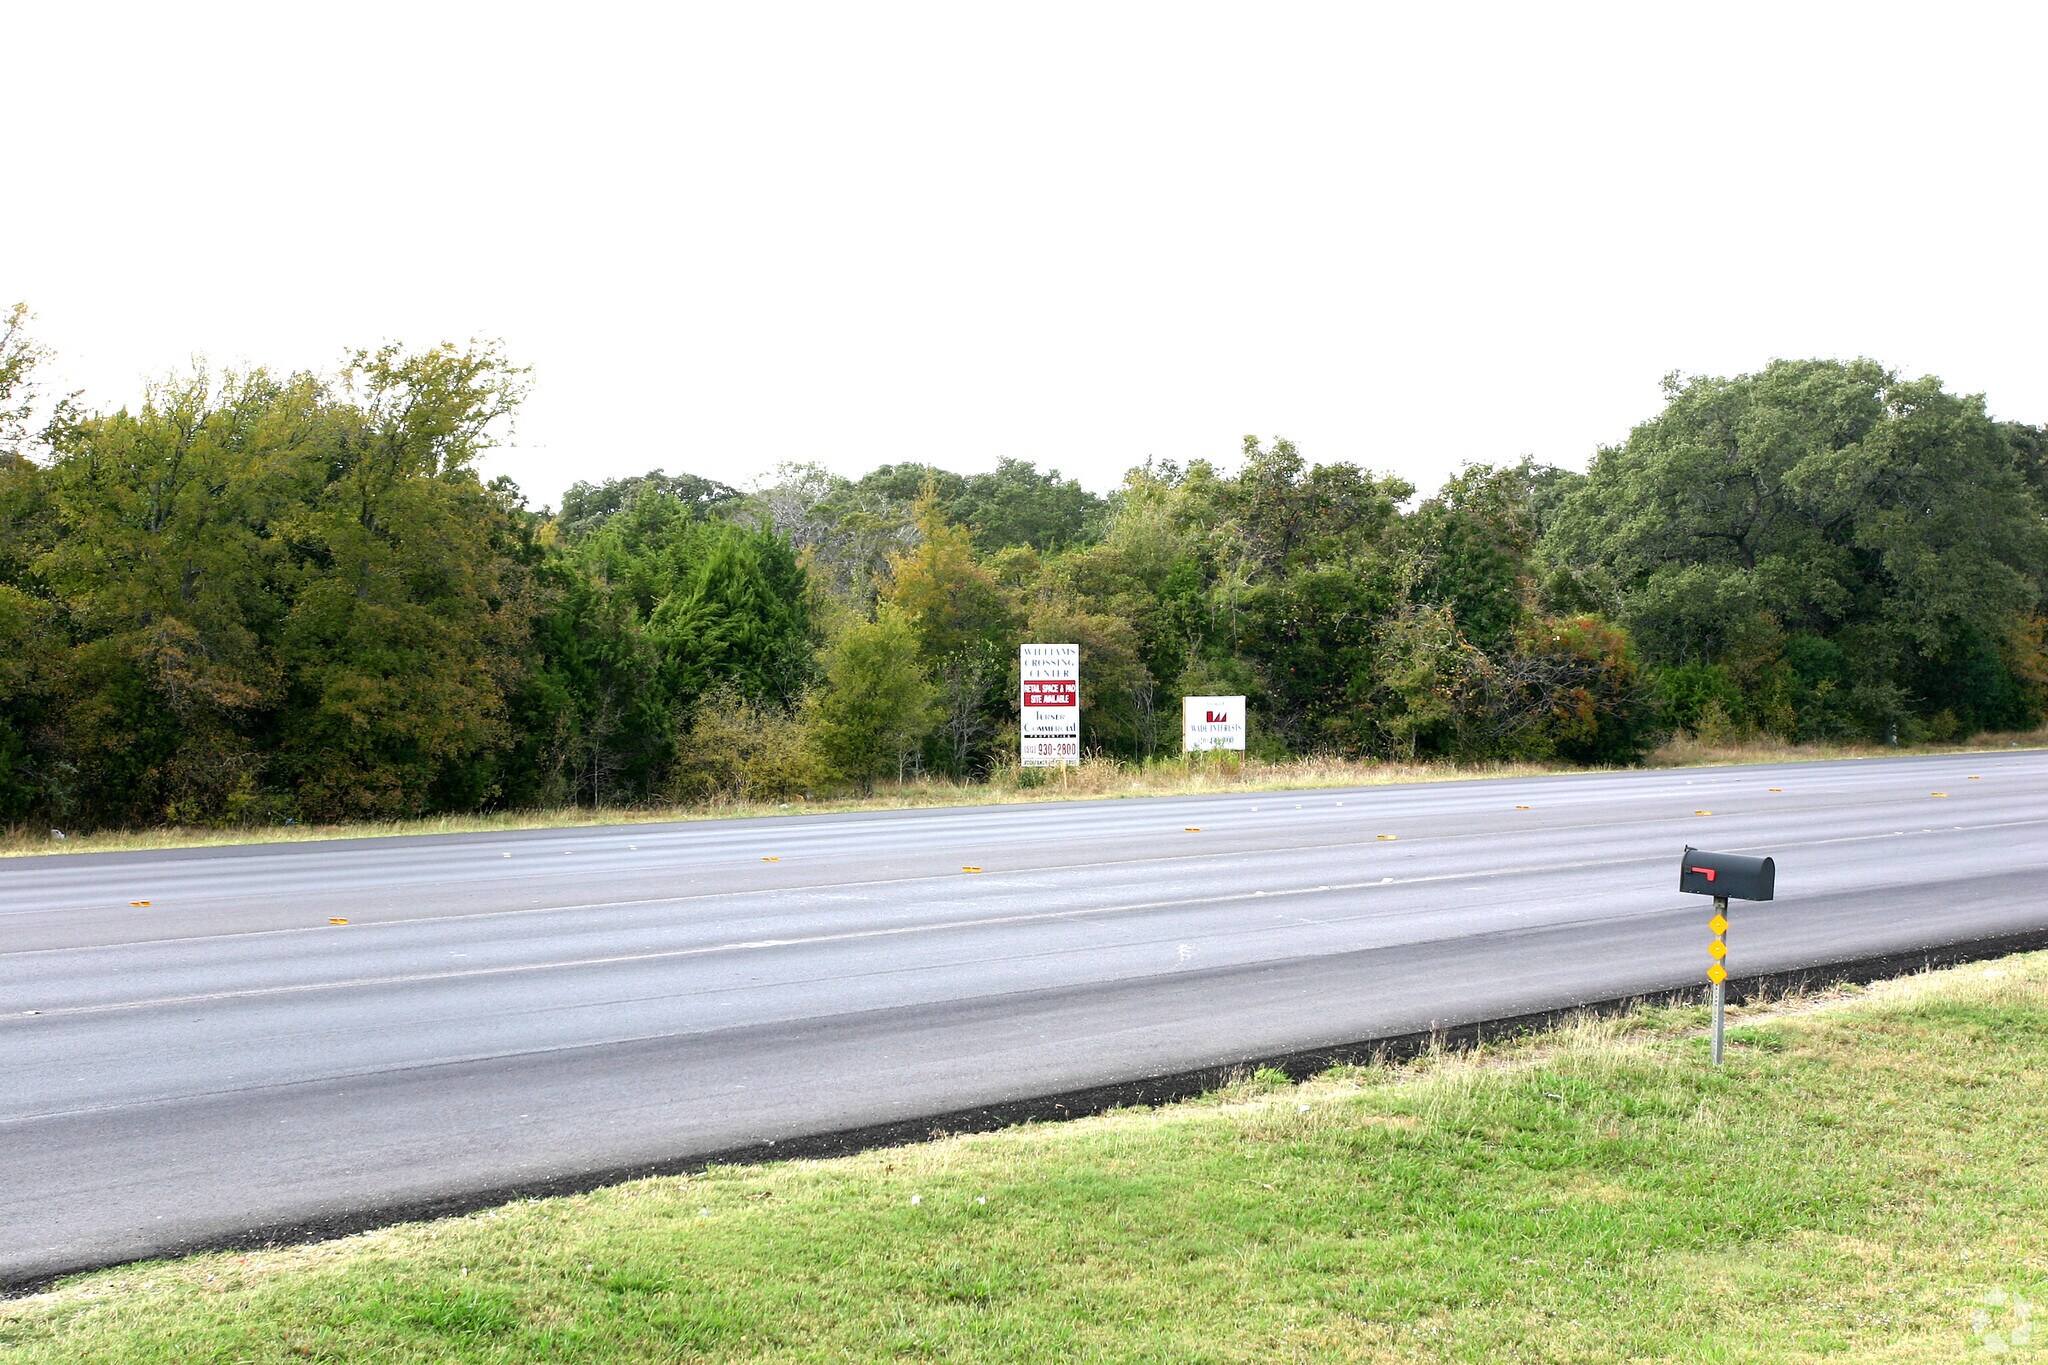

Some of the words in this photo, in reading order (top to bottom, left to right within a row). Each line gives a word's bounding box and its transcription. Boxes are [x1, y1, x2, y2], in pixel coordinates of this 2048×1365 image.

[1024, 648, 1076, 656] WILLIAMS
[1024, 659, 1075, 667] CROSSING
[1029, 670, 1069, 678] CENTER
[1024, 684, 1041, 693] RETAIL
[1042, 684, 1059, 693] SPACE
[1065, 684, 1076, 693] PAD
[1030, 694, 1042, 704] SITE
[1043, 694, 1070, 703] AVAILABLE
[1210, 724, 1242, 732] INTERESTS
[1038, 743, 1076, 756] 930-2800
